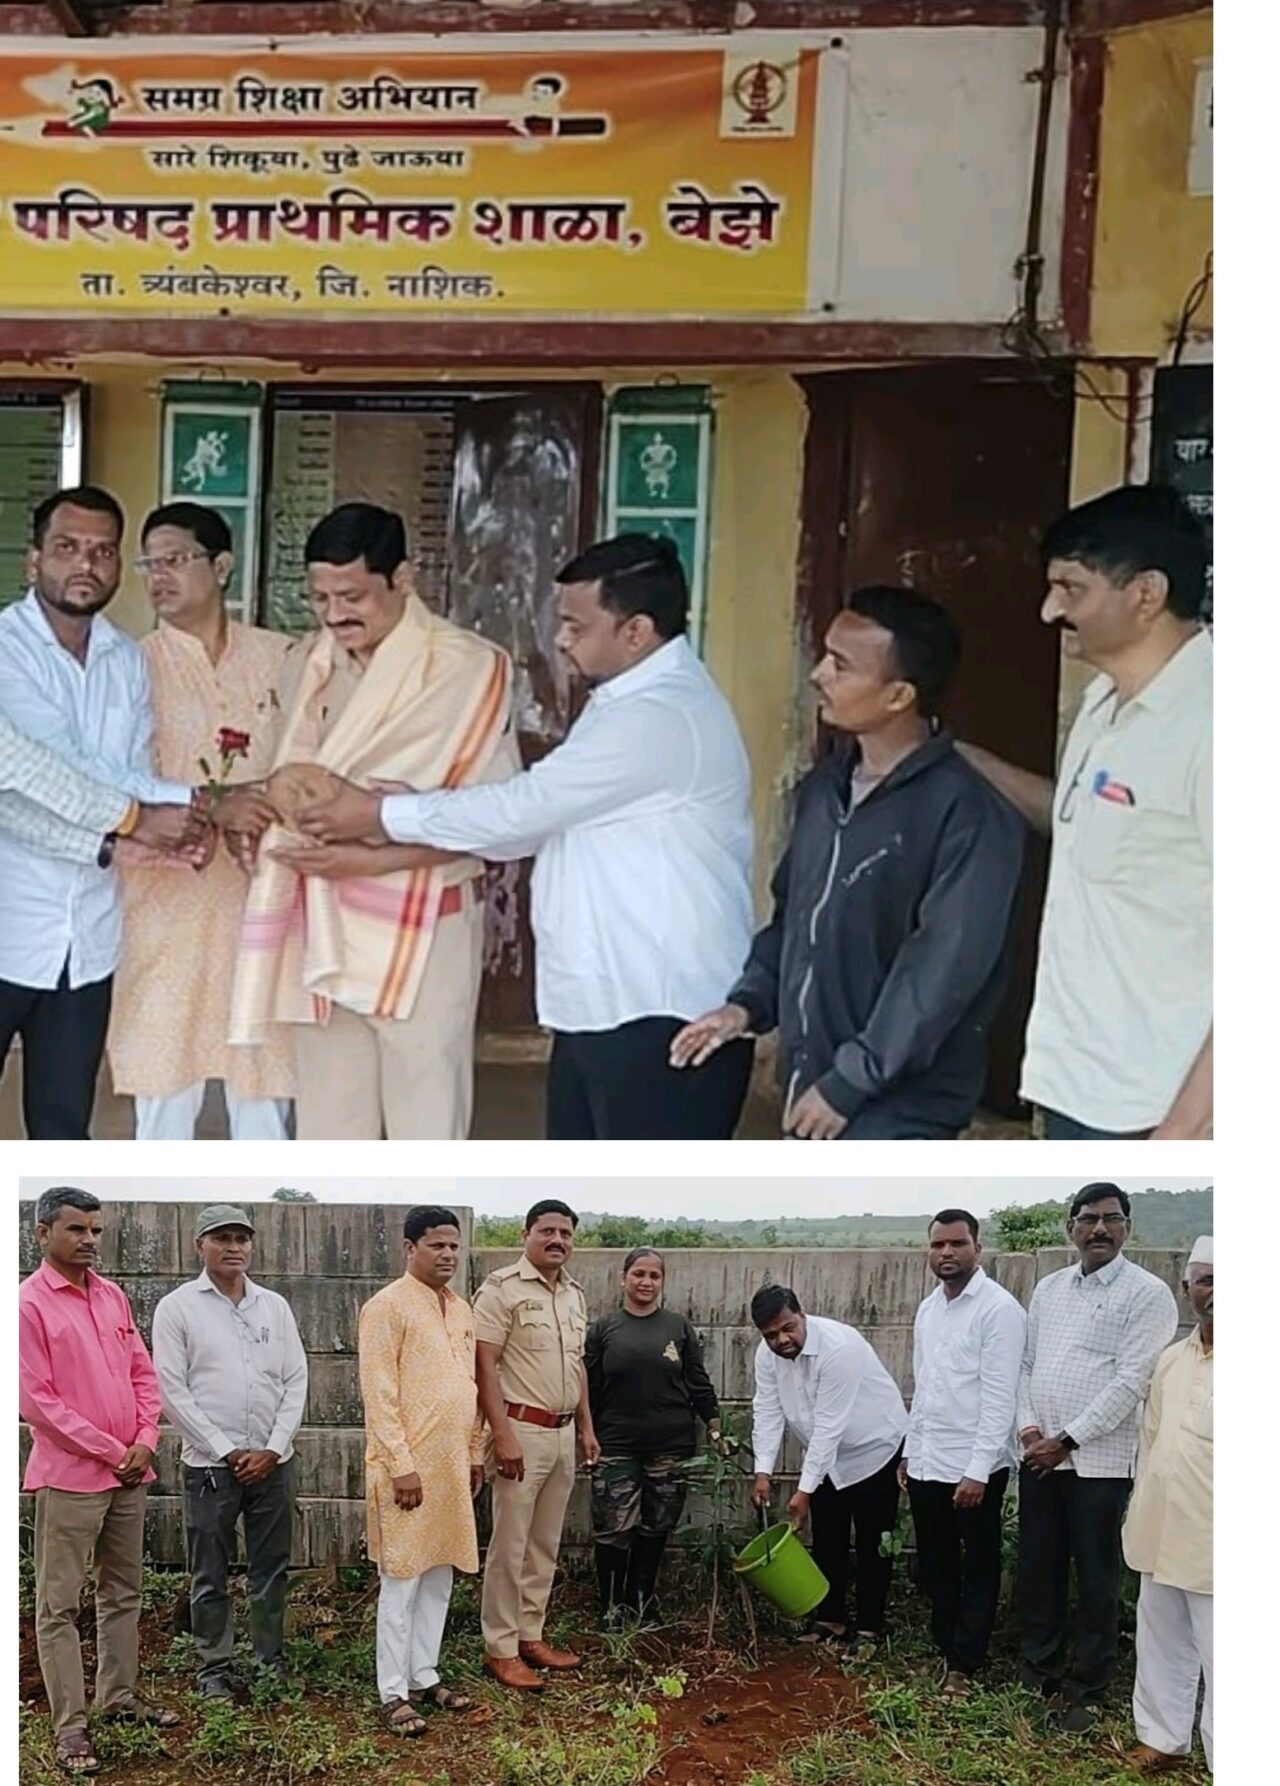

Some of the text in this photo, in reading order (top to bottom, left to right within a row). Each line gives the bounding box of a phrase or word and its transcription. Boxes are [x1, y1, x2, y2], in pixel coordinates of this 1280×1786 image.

[140, 75, 480, 115] समग्र शिक्षा अभियान
[150, 144, 198, 168] सारे
[321, 143, 361, 175] पुढे
[13, 188, 195, 250] परिषद
[211, 187, 455, 242] प्राथमिक
[473, 200, 643, 248] शाळा,
[667, 185, 780, 250] बेझे
[80, 272, 125, 297] ता.
[315, 265, 370, 298] जि.
[384, 265, 506, 299] नाशिक.
